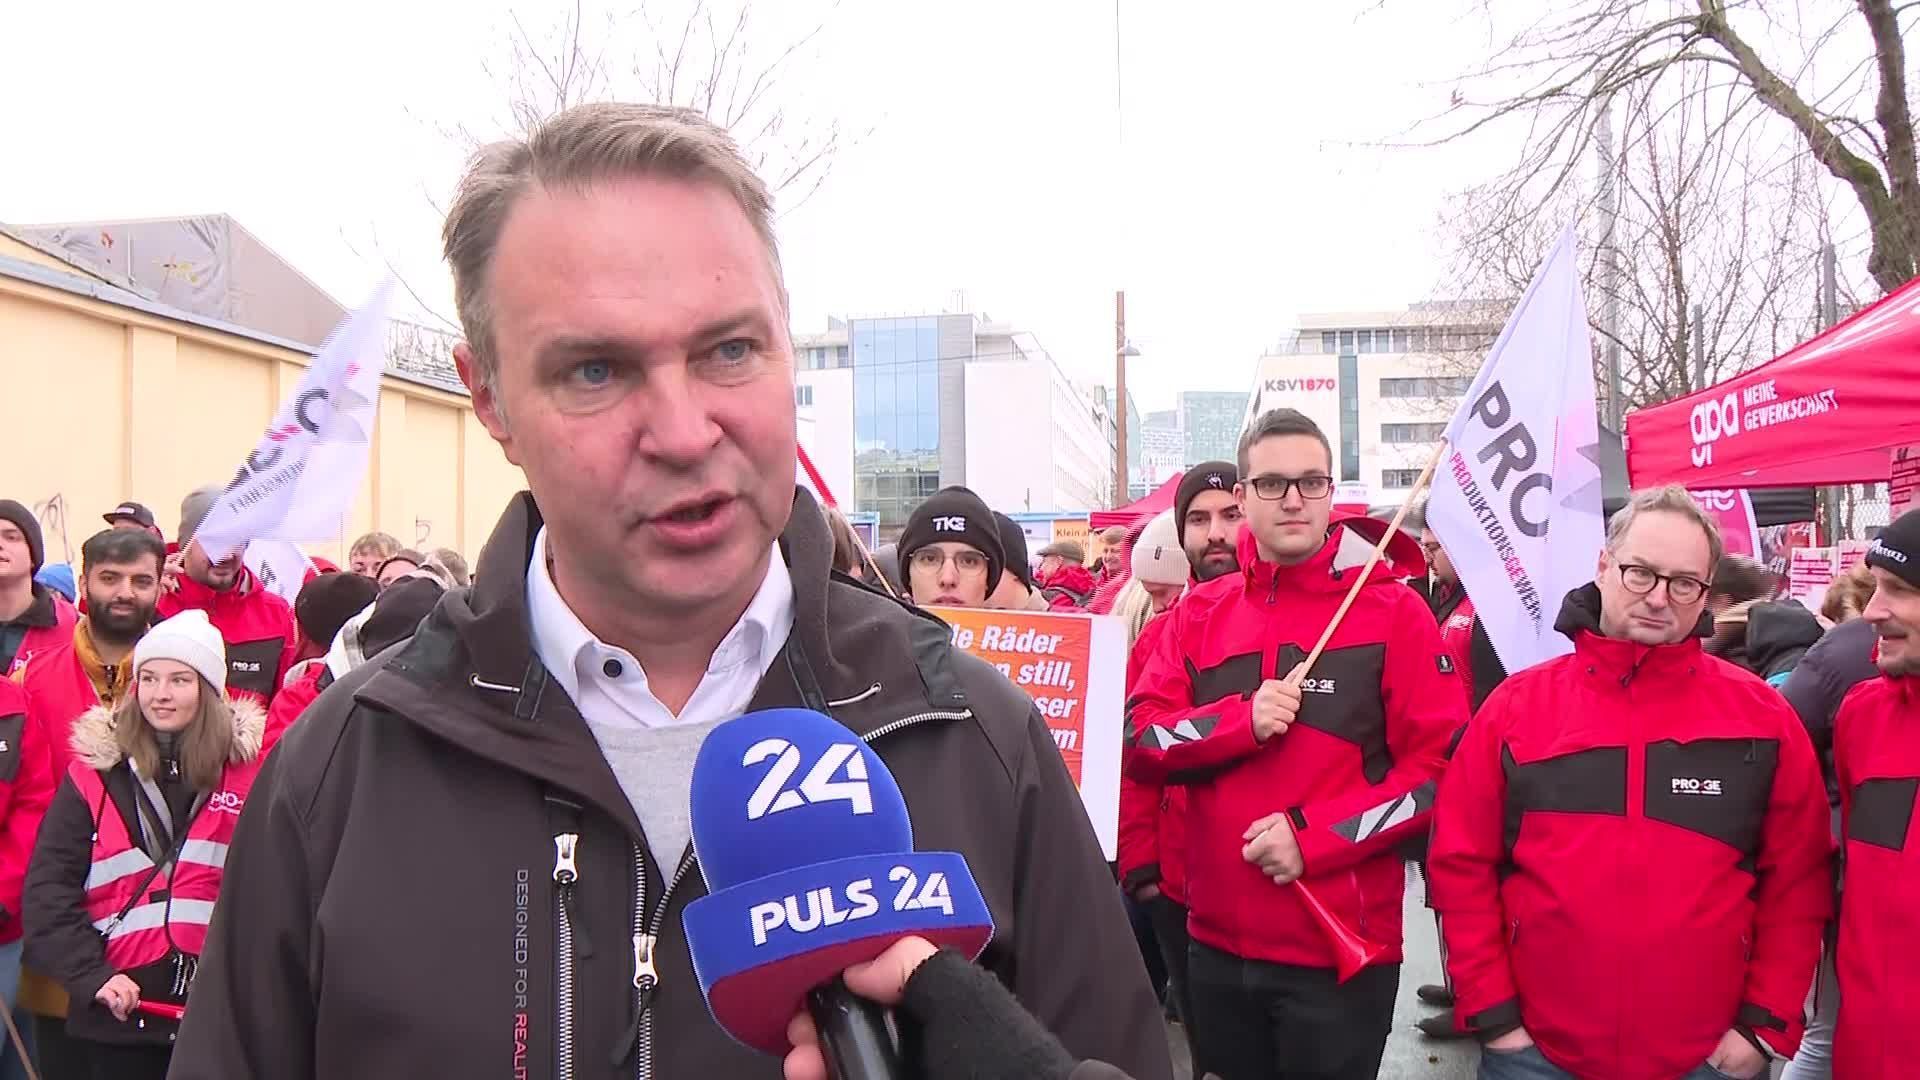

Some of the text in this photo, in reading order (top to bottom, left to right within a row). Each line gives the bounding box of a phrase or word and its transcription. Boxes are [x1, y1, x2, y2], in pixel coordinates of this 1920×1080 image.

[1264, 378, 1336, 392] KSV1870
[1743, 379, 1779, 408] MEINE
[1743, 388, 1839, 432] GEWERKSCHAFT
[932, 516, 966, 532] TKE
[1056, 528, 1080, 537] Klein
[981, 624, 1063, 654] Räder
[1017, 660, 1076, 691] still,
[1032, 696, 1078, 718] ser
[742, 738, 874, 821] 24
[516, 869, 529, 964] DESIGNED
[748, 866, 954, 946] PULS 24
[514, 968, 528, 1009] FOR
